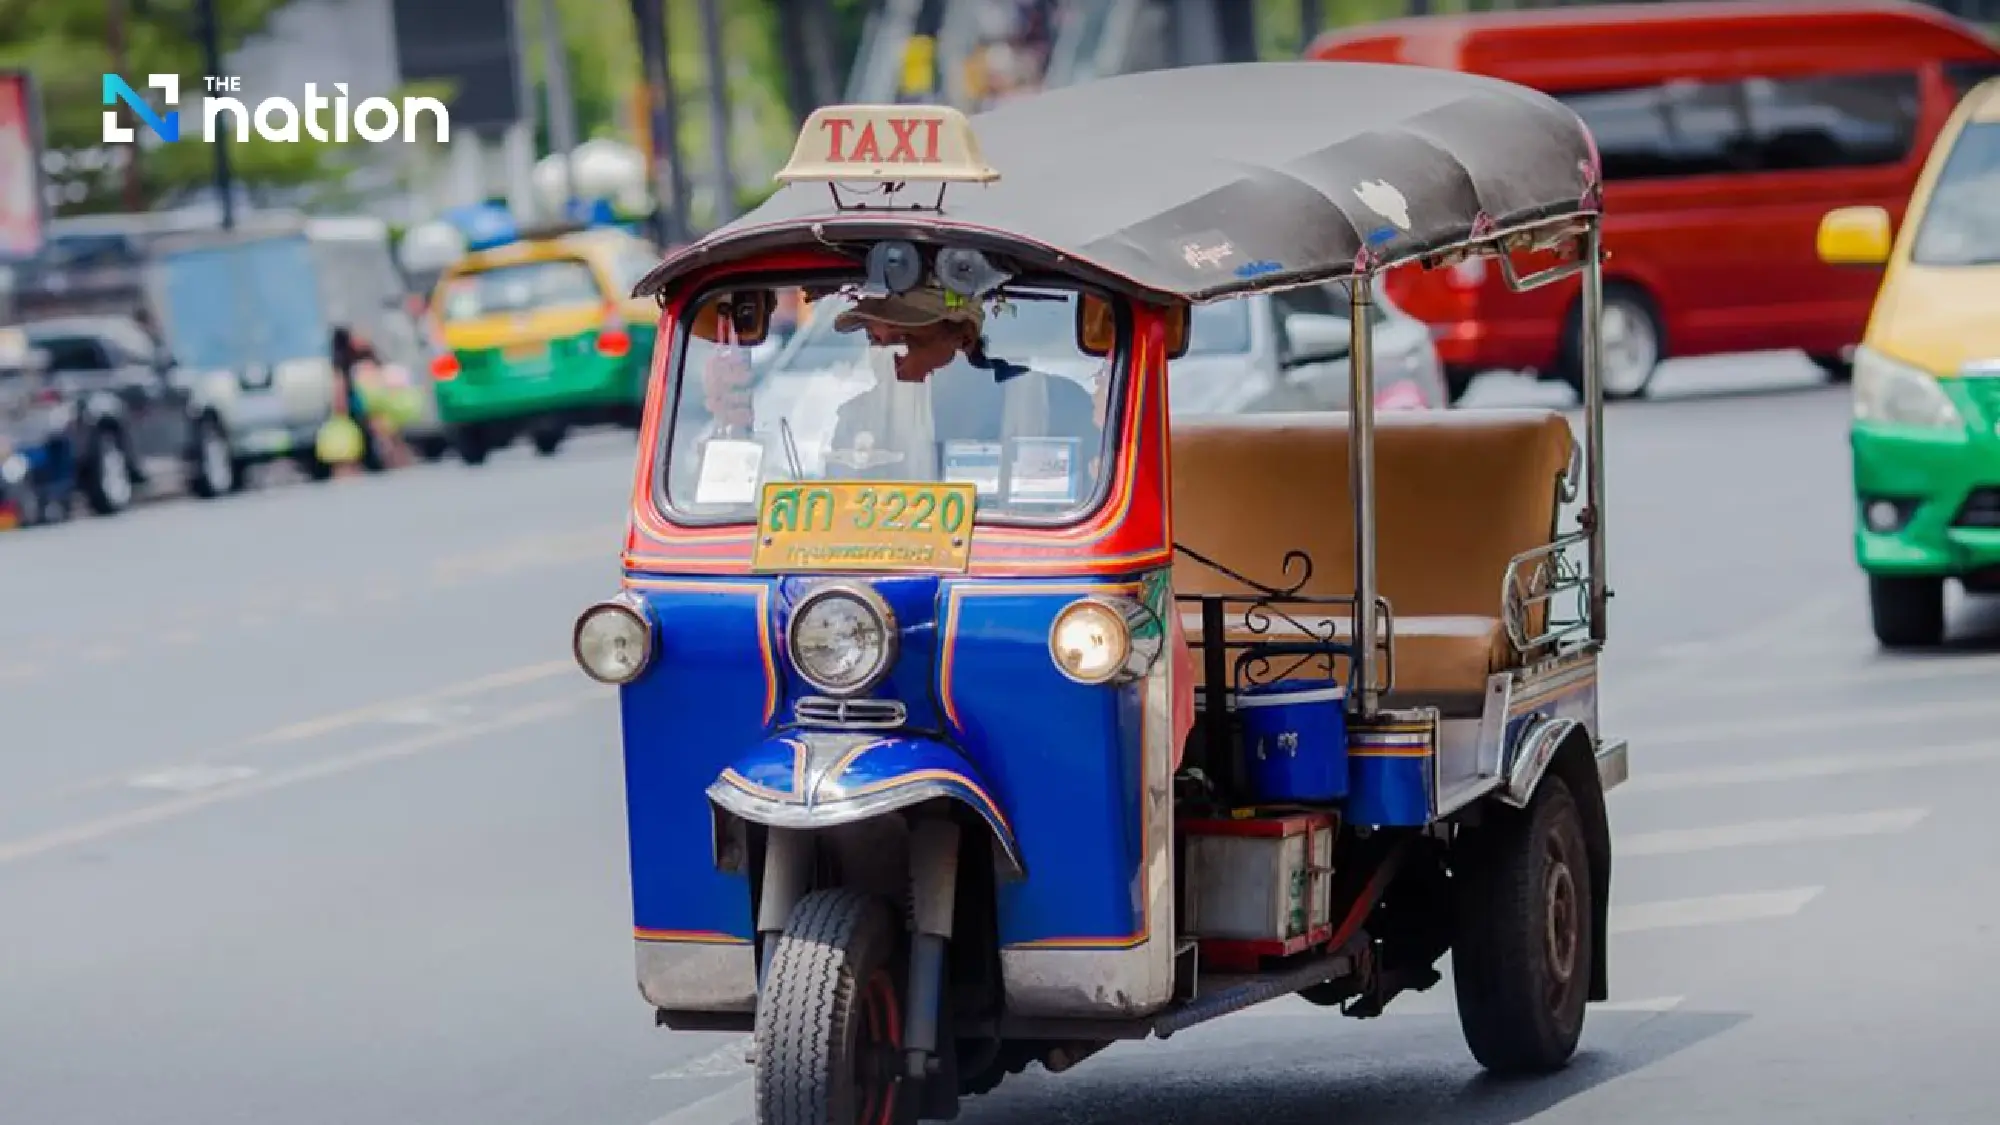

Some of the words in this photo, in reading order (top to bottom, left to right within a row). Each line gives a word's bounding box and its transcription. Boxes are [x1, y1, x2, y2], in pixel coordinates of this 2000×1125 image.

[820, 118, 944, 163] TAXI
[770, 487, 834, 532] สก
[853, 487, 965, 533] 3220
